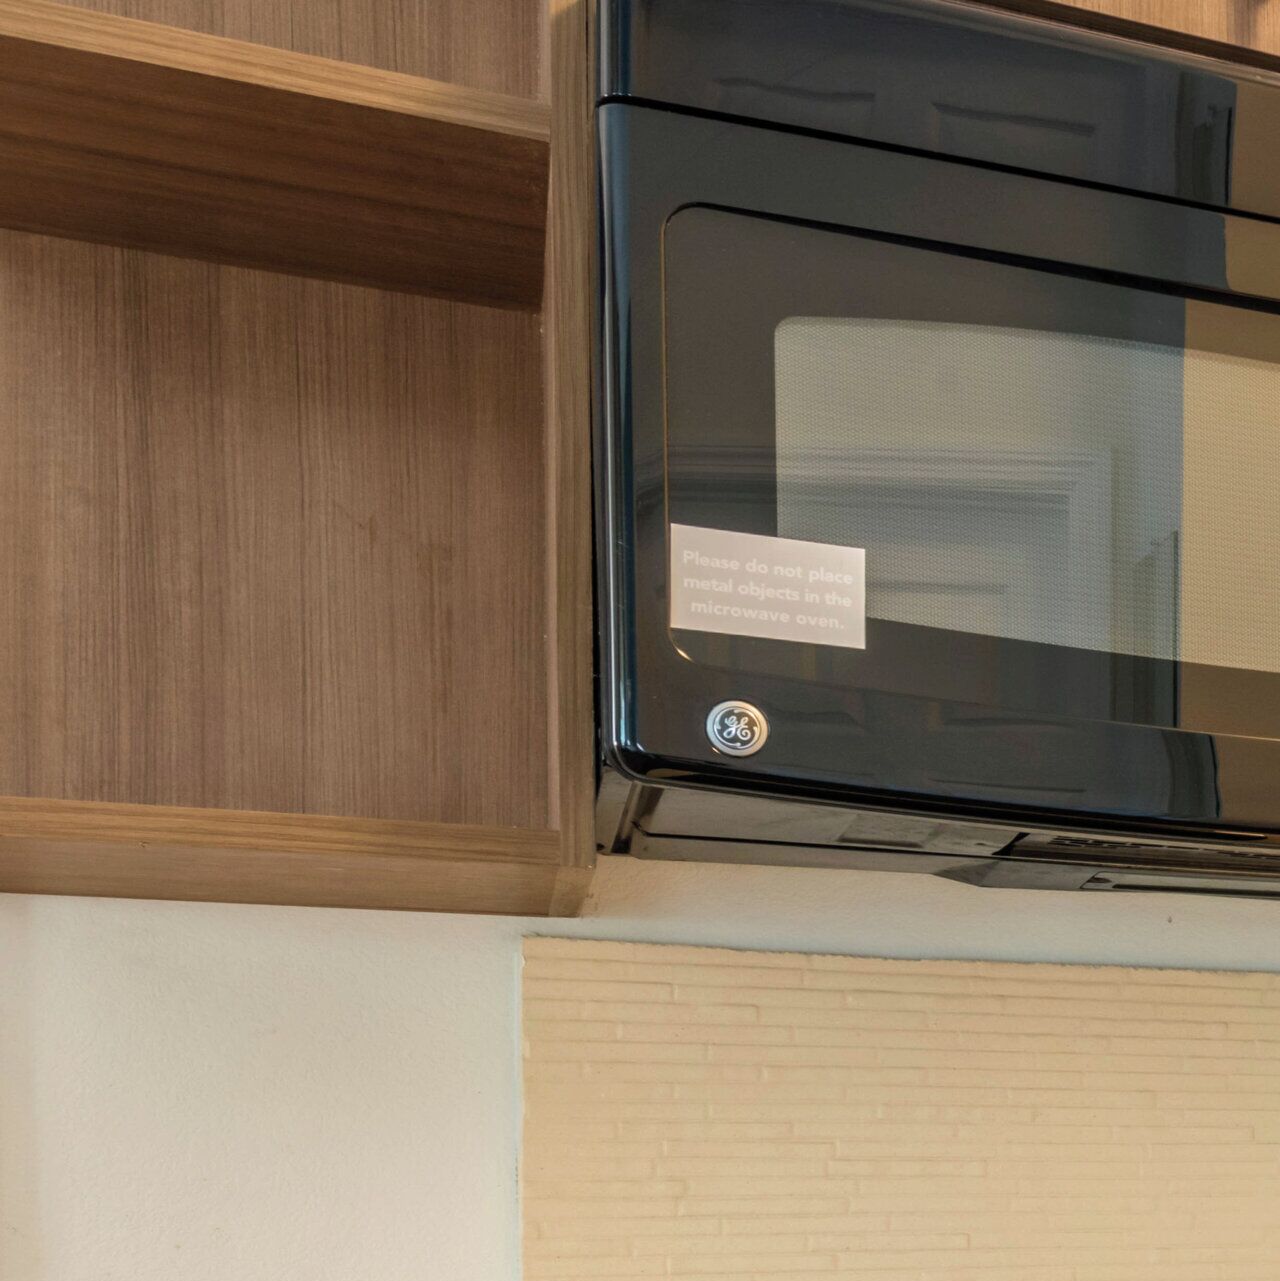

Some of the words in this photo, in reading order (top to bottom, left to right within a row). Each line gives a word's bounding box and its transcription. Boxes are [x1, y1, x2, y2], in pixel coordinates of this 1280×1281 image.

[683, 550, 740, 571] Please
[746, 558, 768, 574] do
[773, 566, 802, 579] not
[808, 566, 853, 585] place
[684, 576, 732, 592] metal
[738, 581, 800, 602] objects
[804, 588, 820, 604] in
[825, 592, 852, 607] the
[690, 600, 790, 622] microwave
[796, 614, 844, 629] oven.
